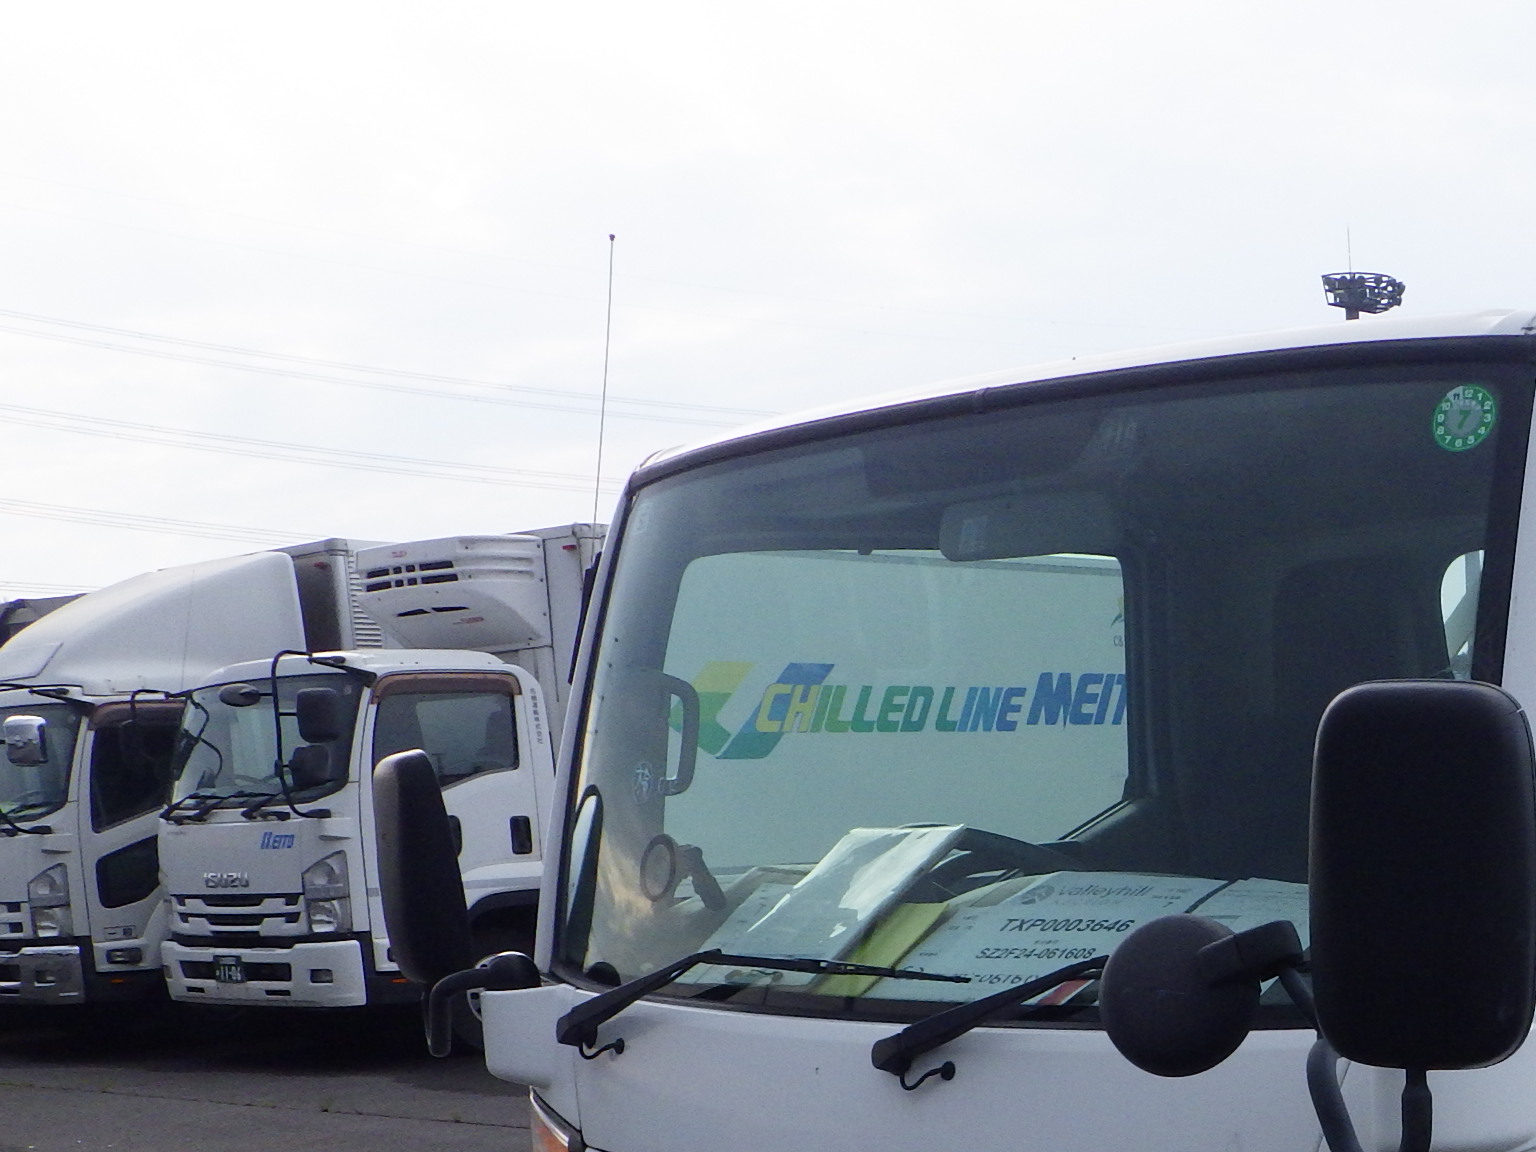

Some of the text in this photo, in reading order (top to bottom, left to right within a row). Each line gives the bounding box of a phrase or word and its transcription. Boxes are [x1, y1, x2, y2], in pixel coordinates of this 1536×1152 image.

[1441, 402, 1450, 410] 10
[1484, 401, 1491, 409] 2
[1437, 414, 1444, 422] 9
[1458, 410, 1471, 429] 7
[1484, 414, 1491, 422] 3
[1437, 426, 1444, 435] 8
[1445, 436, 1451, 444] 7
[1455, 439, 1462, 447] 6
[1467, 436, 1475, 444] 5
[755, 683, 935, 733] CHILLED
[935, 684, 1027, 732] LINE
[203, 872, 249, 888] ISUZU
[1058, 884, 1153, 898] valleyhill
[1000, 918, 1135, 932] TXP0003646
[975, 947, 1097, 959] SZ2F24-061608
